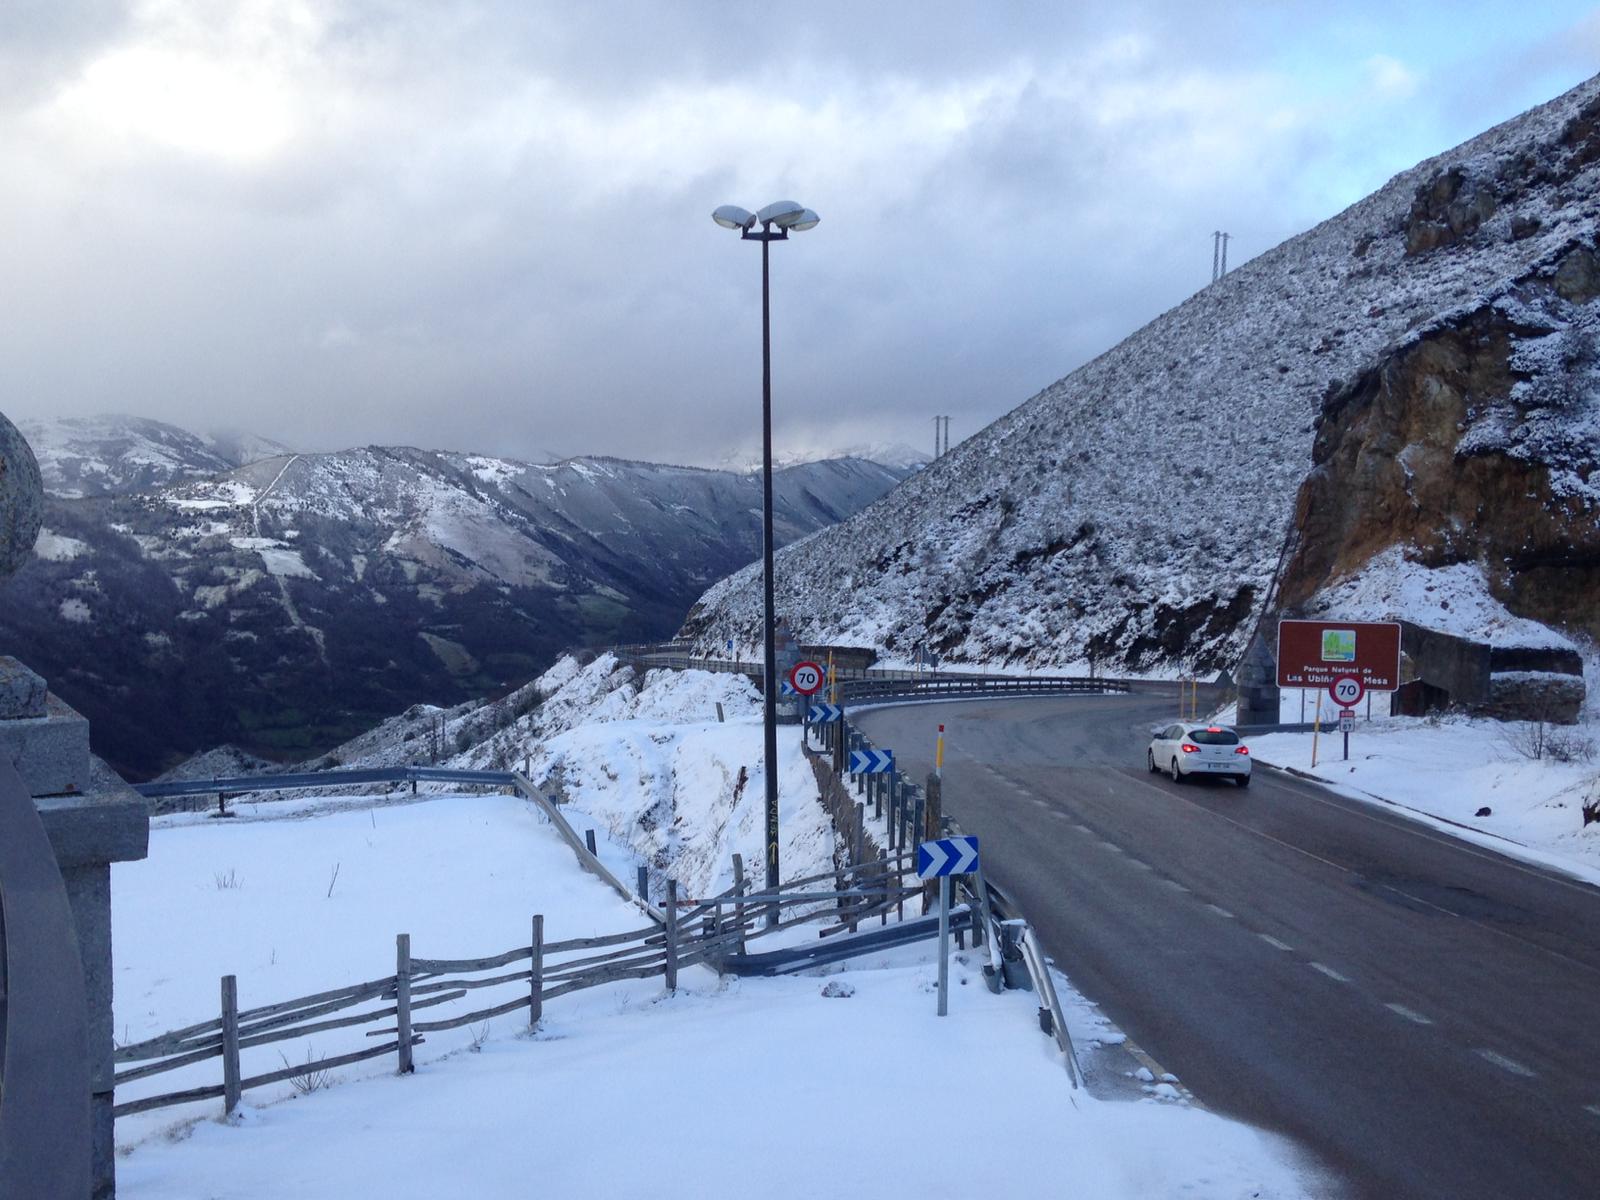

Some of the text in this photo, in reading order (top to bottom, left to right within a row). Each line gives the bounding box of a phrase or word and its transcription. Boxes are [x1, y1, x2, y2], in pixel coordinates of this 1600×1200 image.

[1303, 665, 1329, 674] Parque
[1331, 666, 1359, 674] Natural
[799, 673, 815, 684] 70
[1287, 674, 1303, 682] Las
[1363, 676, 1389, 685] Mesa
[1338, 685, 1357, 696] 70
